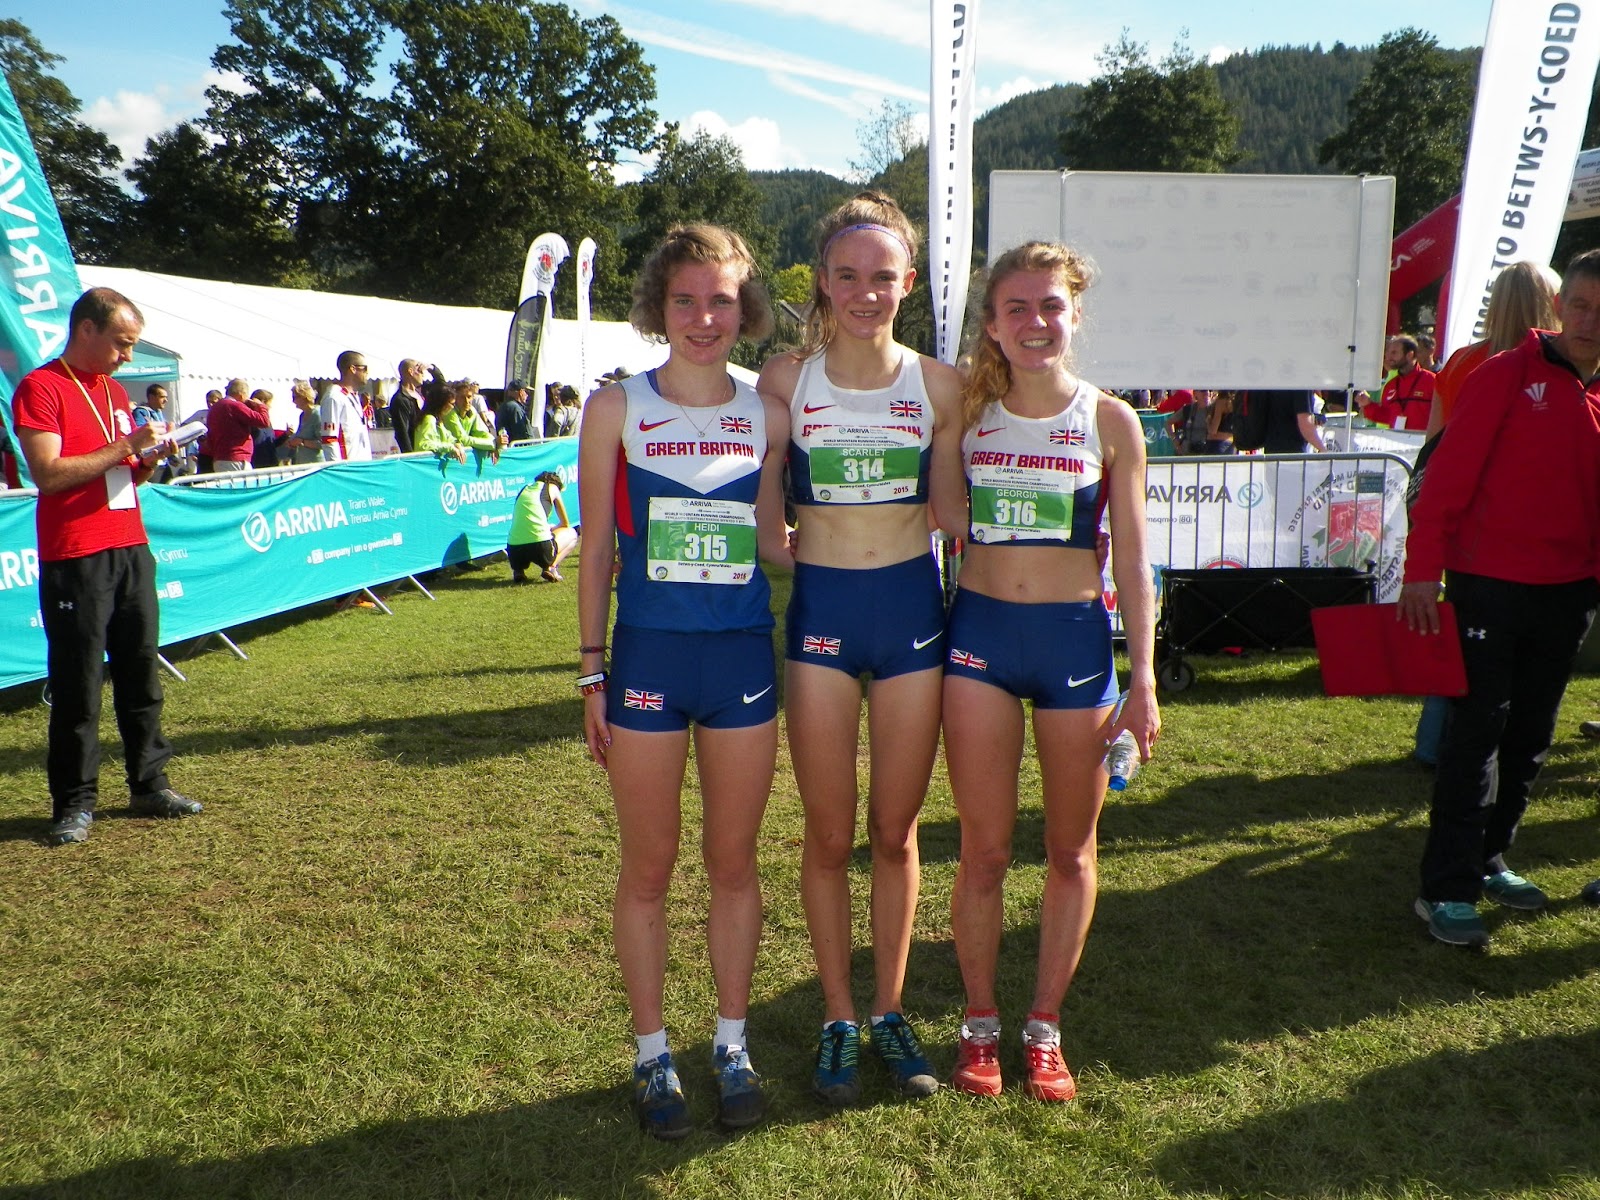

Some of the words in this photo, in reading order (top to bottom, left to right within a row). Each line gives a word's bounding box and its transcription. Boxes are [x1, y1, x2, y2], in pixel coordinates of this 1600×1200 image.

[1502, 2, 1581, 230] BETWS-Y-COED
[645, 442, 696, 457] GREAT
[699, 441, 754, 458] BRITAIN
[842, 448, 887, 457] SCARLET
[843, 458, 885, 483] 314
[970, 451, 1016, 466] GREAT
[1017, 455, 1085, 474] BRITAIN
[459, 479, 506, 506] ARRIVA
[893, 486, 909, 495] 2015
[996, 488, 1039, 500] GEORGIA
[274, 501, 349, 540] ARRIVA
[389, 507, 408, 519] Cymru
[996, 498, 1037, 527] 316
[694, 522, 720, 532] HEIDI
[159, 548, 189, 564] Cymru
[684, 533, 728, 561] 315
